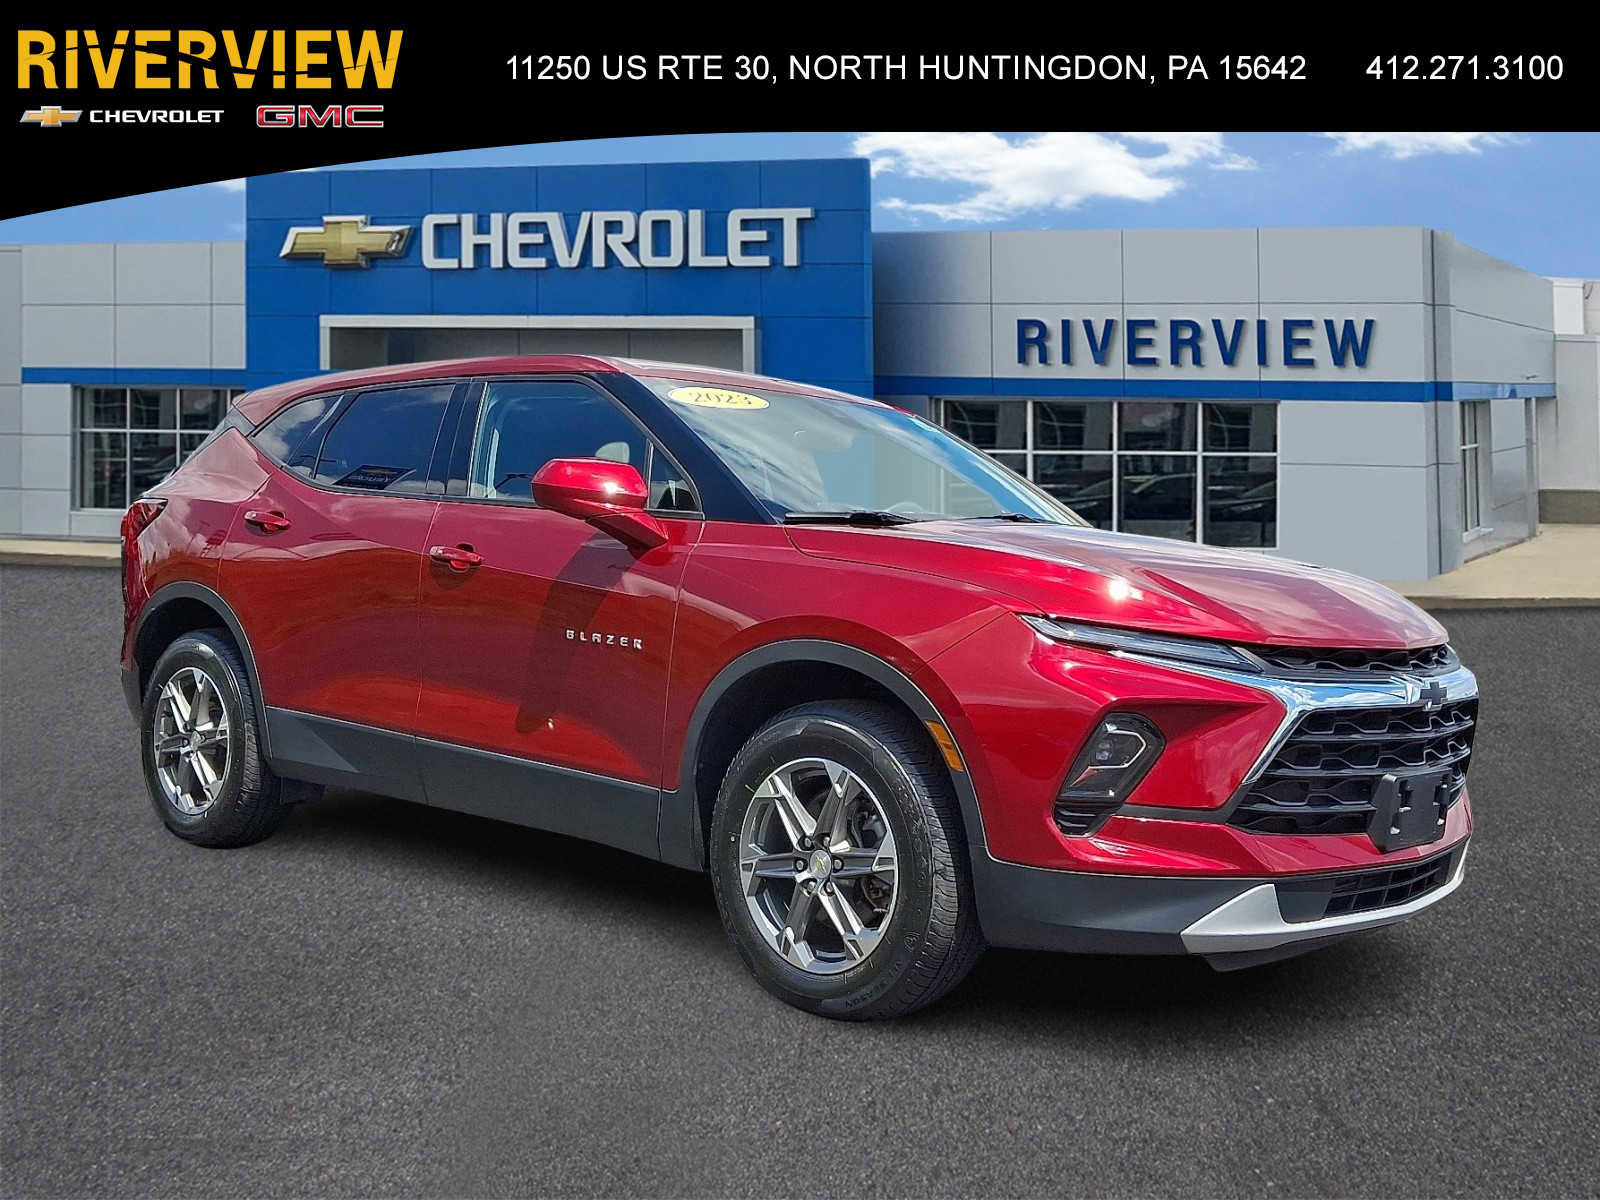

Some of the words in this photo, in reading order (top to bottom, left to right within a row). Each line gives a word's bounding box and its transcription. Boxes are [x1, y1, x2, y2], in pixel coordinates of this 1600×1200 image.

[421, 207, 815, 270] CHEVROLET
[1016, 318, 1375, 367] RIVERVIEW
[566, 629, 643, 650] BLAZER
